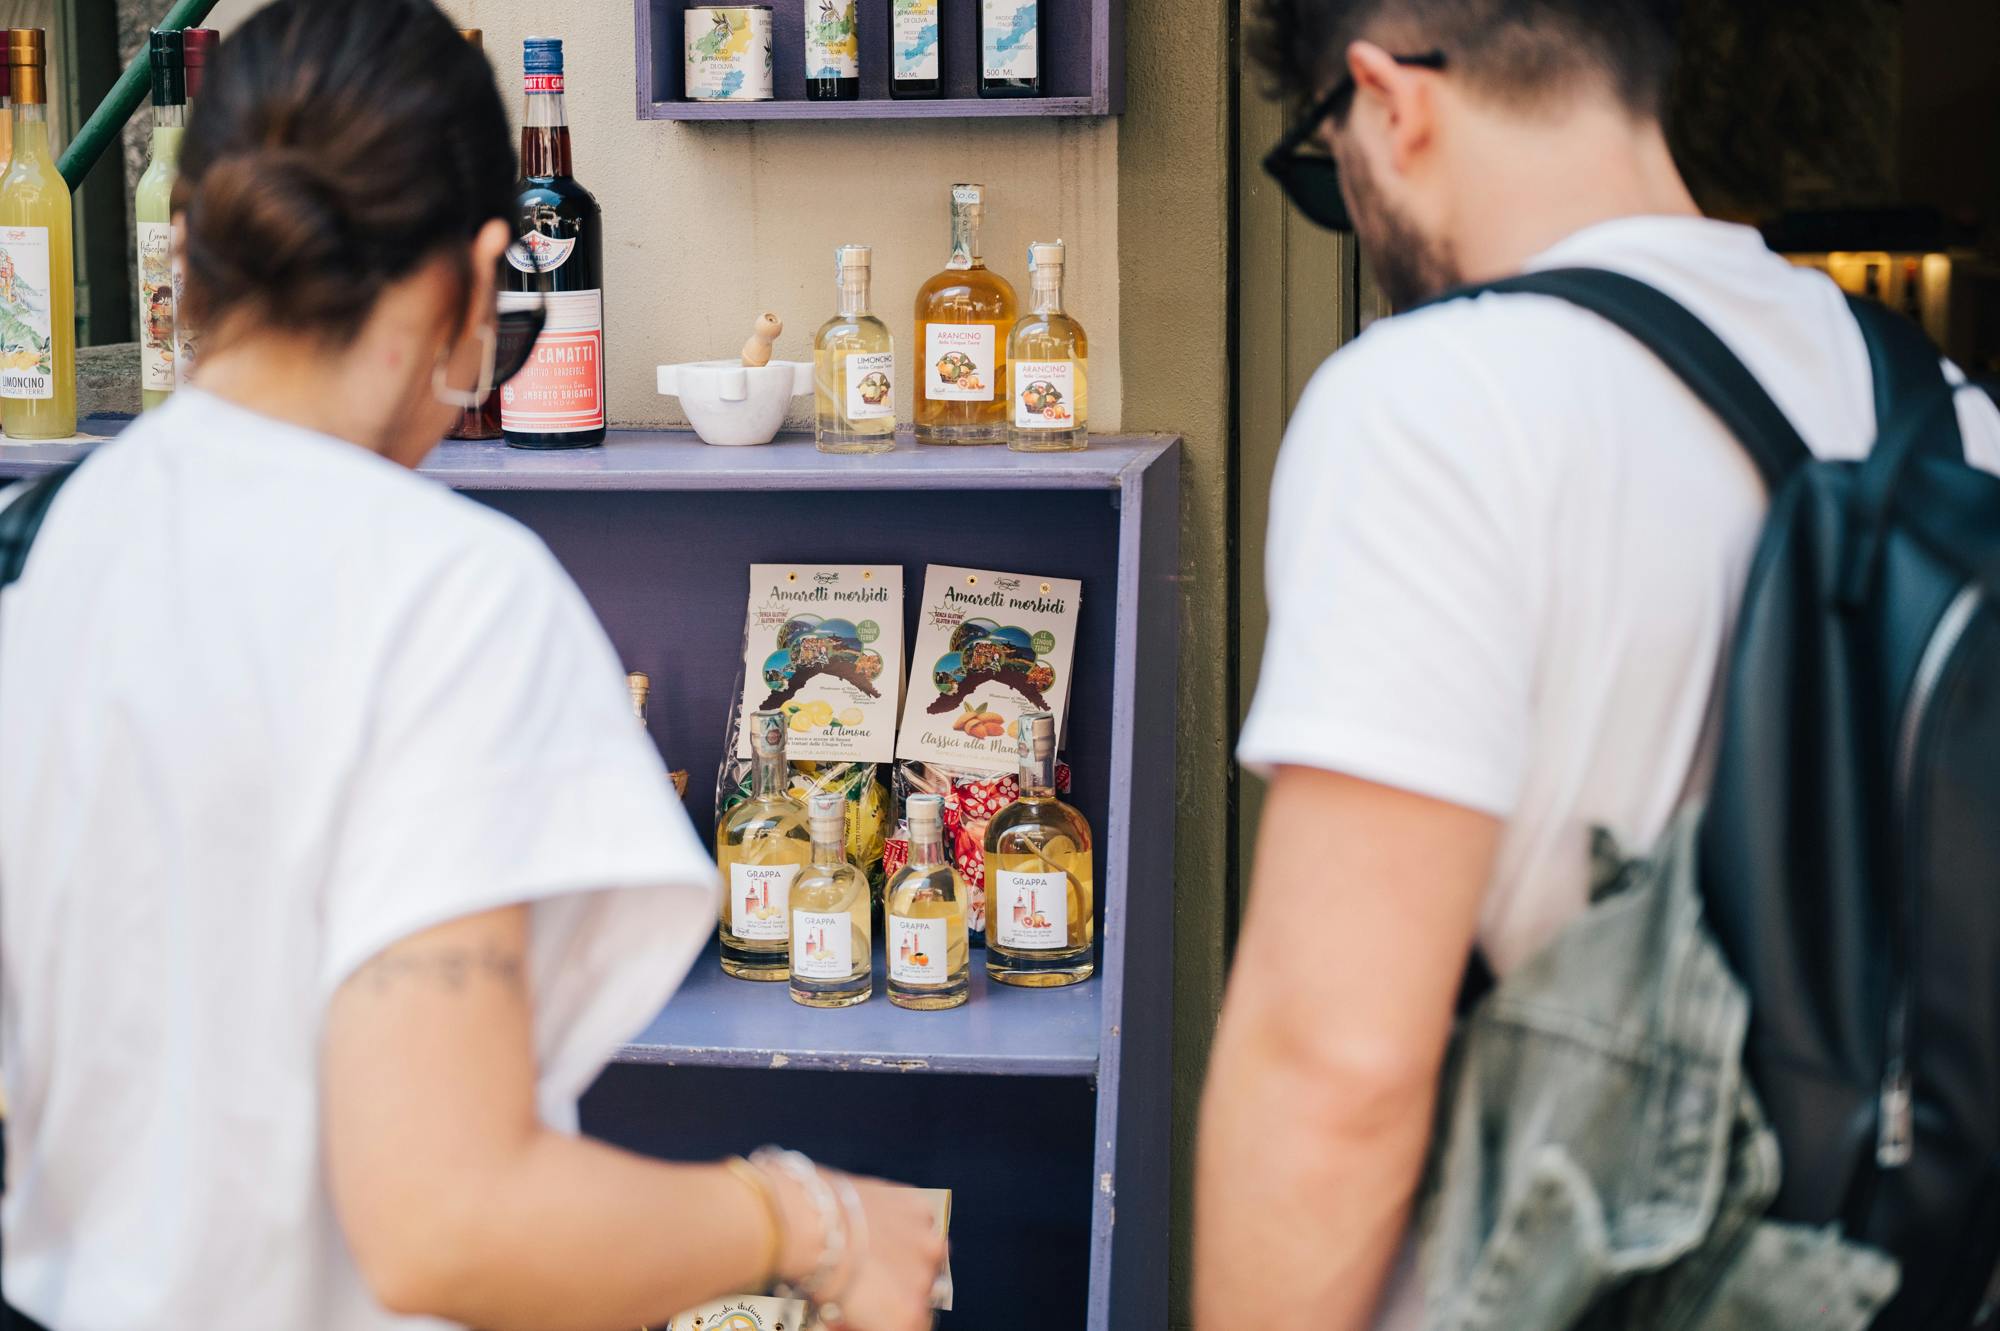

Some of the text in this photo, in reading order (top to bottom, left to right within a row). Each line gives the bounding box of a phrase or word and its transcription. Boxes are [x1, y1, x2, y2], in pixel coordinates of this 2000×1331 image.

[986, 68, 1014, 76] 500 ML
[937, 331, 982, 340] ARANCINO
[537, 345, 593, 363] CAMATTI
[857, 354, 892, 364] LIMONCINO
[1023, 365, 1066, 373] ARANCINO
[2, 376, 45, 389] LIMONCINO
[770, 585, 889, 603] Amaretti morbidi
[944, 585, 1066, 614] Amaretti morbidi
[822, 727, 872, 738] al limone
[920, 731, 960, 749] Classici
[963, 739, 985, 751] alla
[746, 870, 781, 878] GRAPPA
[1012, 877, 1048, 886] GRAPPA
[804, 917, 836, 926] GRAPPA
[899, 921, 931, 930] GRAPPA
